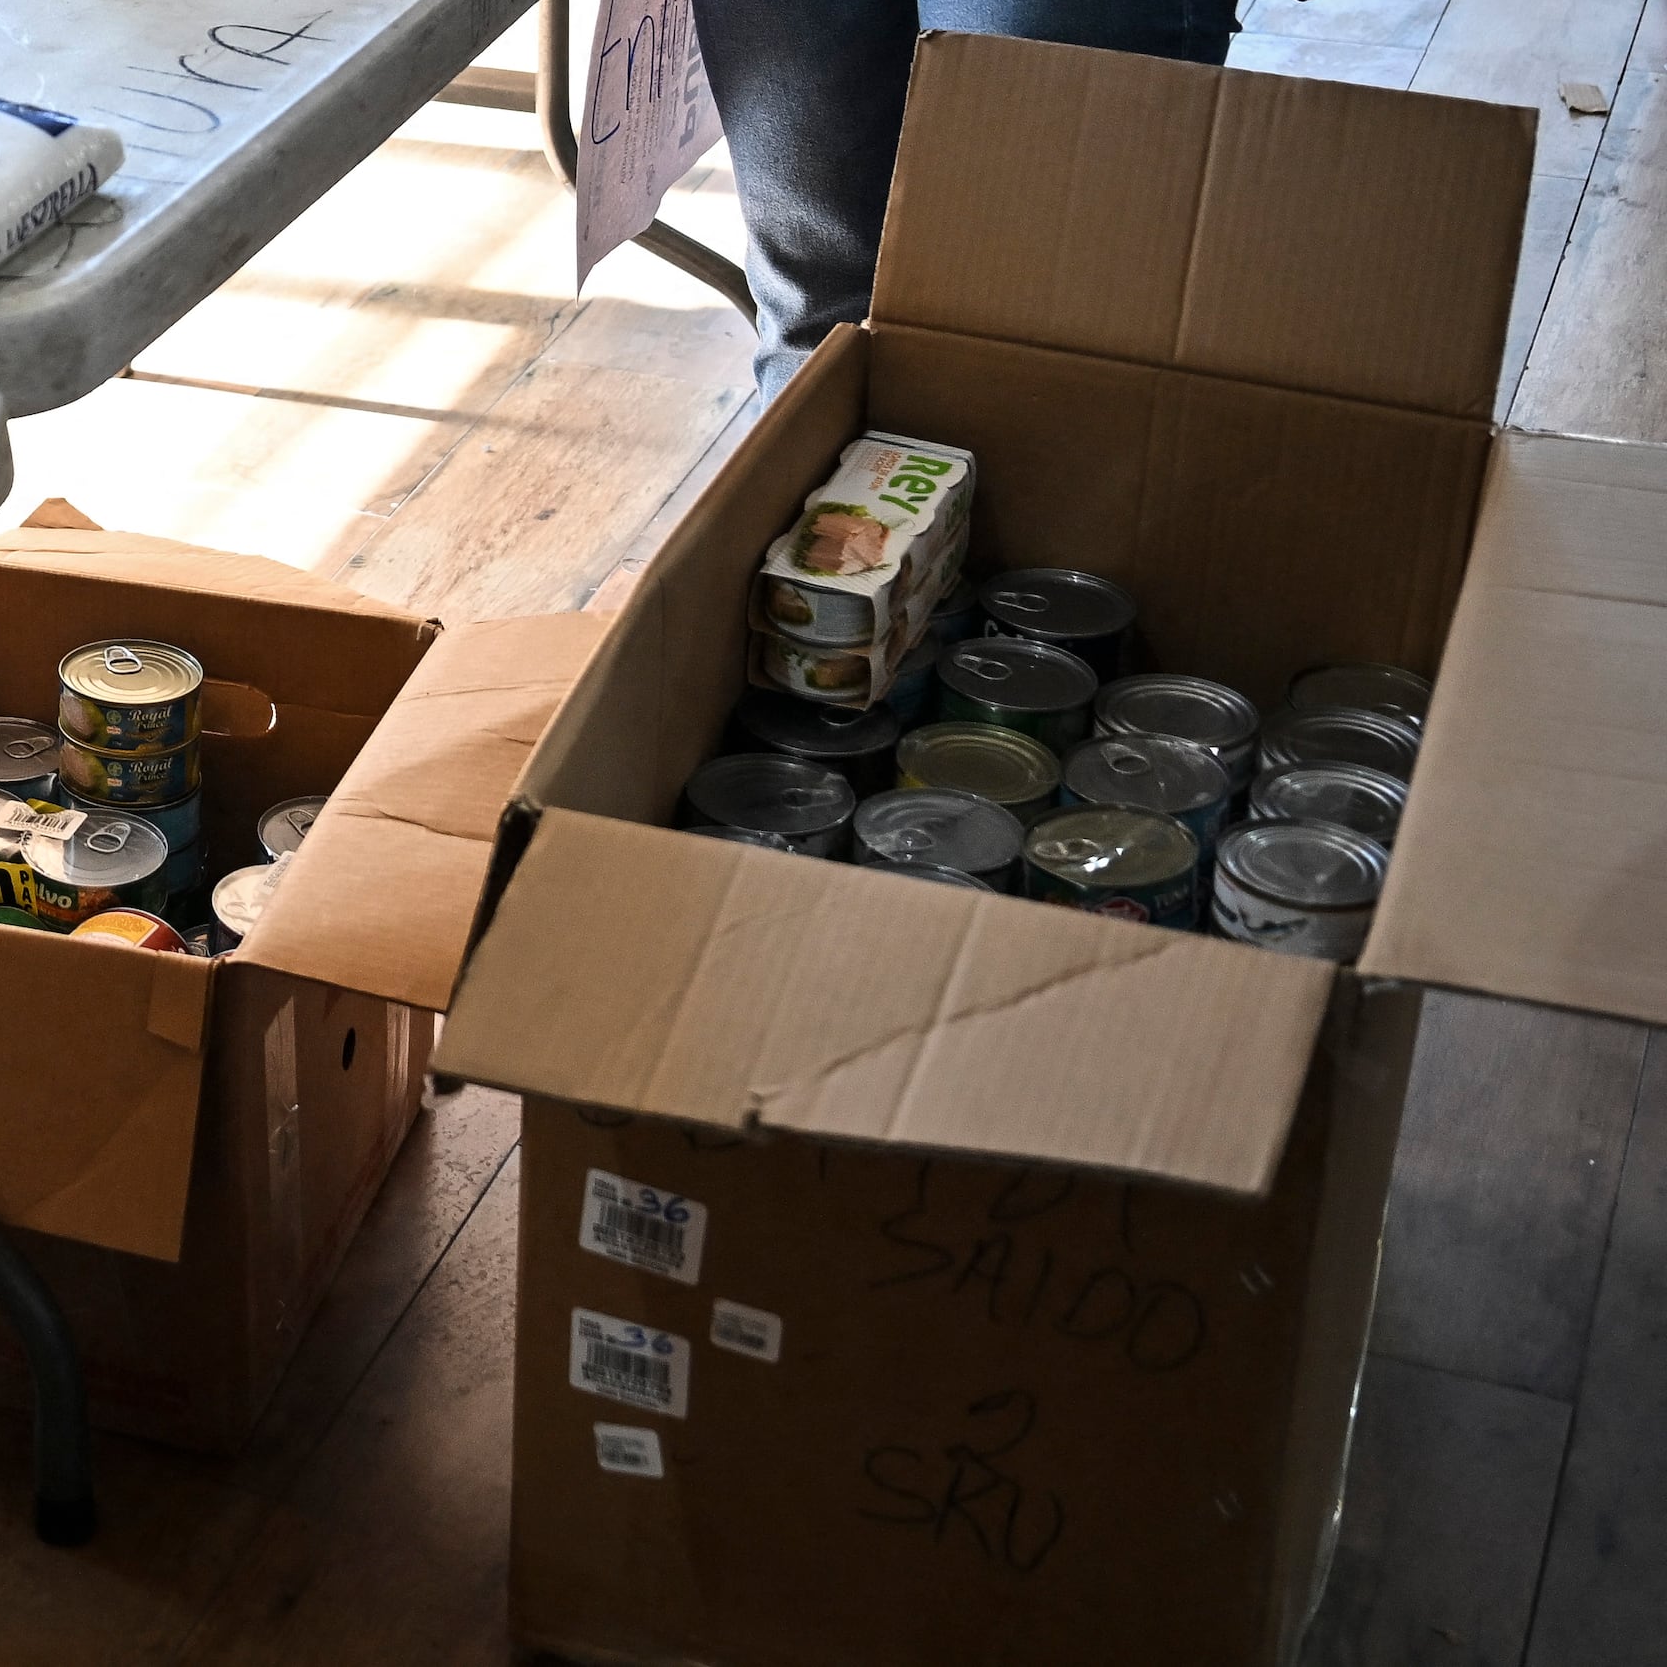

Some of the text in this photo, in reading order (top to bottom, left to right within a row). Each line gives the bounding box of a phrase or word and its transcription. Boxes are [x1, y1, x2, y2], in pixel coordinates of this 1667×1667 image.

[127, 704, 172, 723] Royal
[128, 757, 172, 775] Royal
[37, 879, 72, 909] lvo
